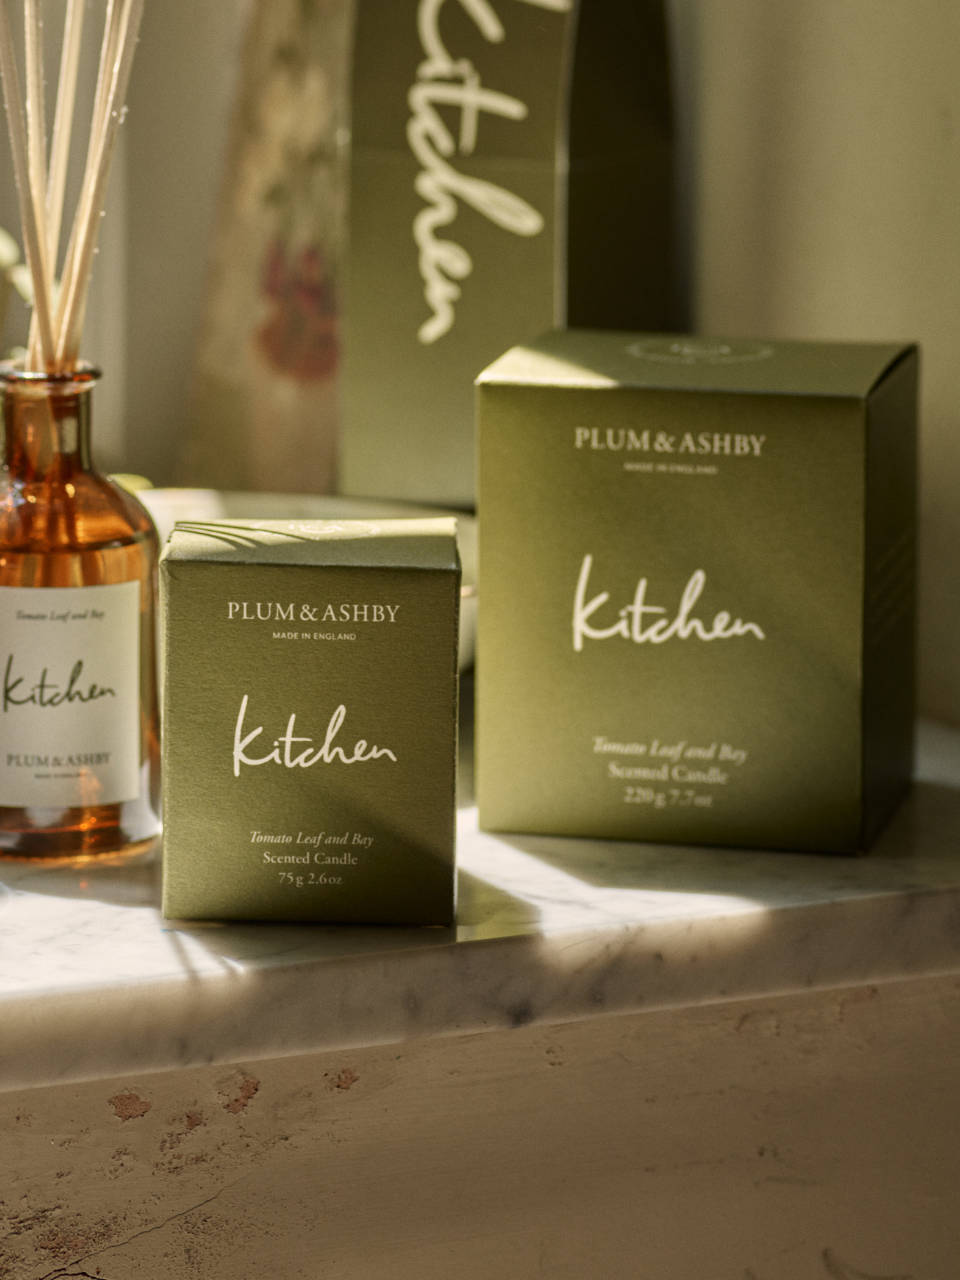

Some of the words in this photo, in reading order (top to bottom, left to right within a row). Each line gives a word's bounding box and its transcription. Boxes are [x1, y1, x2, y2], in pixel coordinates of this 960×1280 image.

[272, 632, 299, 640] MADE
[301, 632, 311, 640] IN
[313, 632, 357, 641] ENGLAND
[250, 831, 293, 844] Tomato
[296, 831, 325, 849] Leaf
[324, 832, 349, 845] and
[351, 832, 375, 849] Bay
[262, 850, 310, 865] Scented
[313, 852, 359, 866] Candle
[278, 872, 304, 888] 75g
[307, 872, 343, 885] 2.6oz
